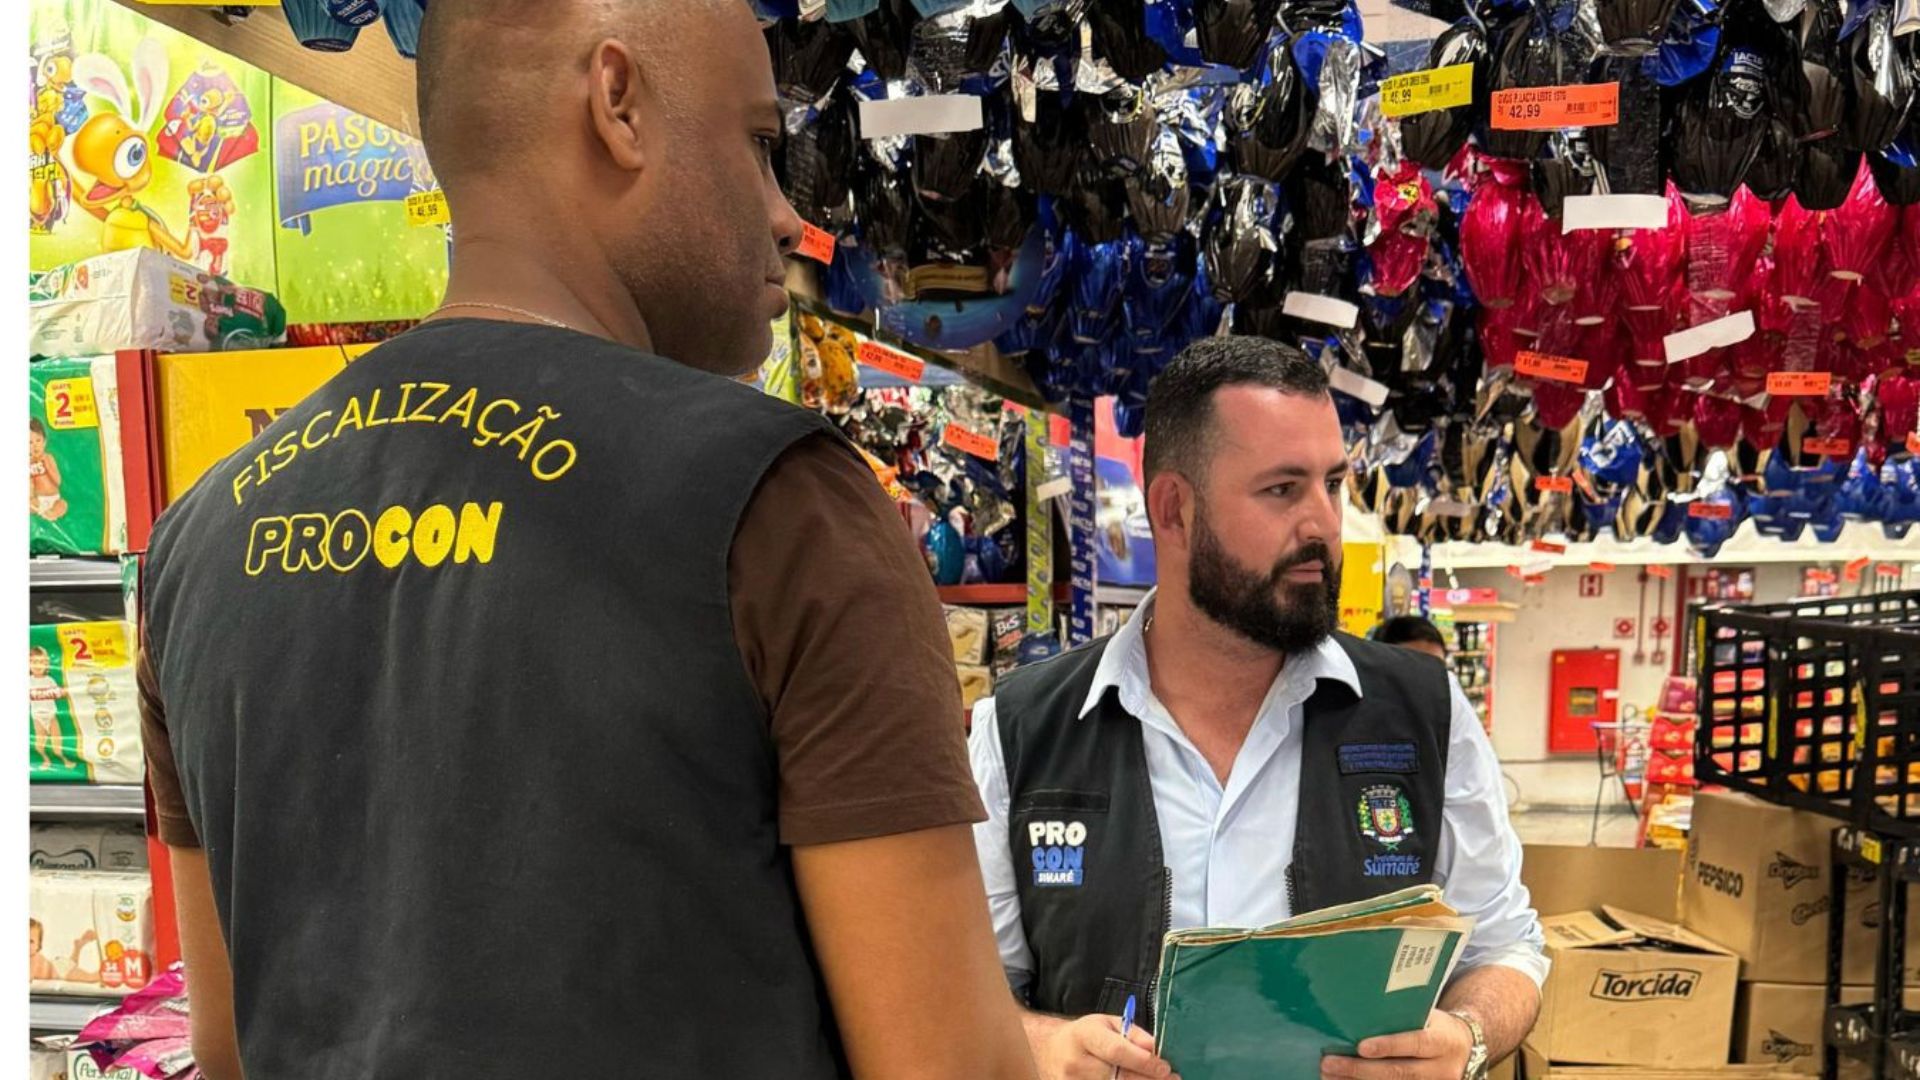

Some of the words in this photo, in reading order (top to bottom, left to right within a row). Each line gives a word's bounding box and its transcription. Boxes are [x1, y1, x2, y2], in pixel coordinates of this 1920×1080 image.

[1509, 104, 1541, 120] 42,99
[55, 392, 72, 418] 2
[232, 381, 578, 505] FISCALIZAÇÃO
[245, 502, 503, 575] PROCON
[70, 638, 93, 661] 2
[1028, 820, 1087, 847] PRO
[1032, 846, 1084, 870] CON
[1363, 857, 1421, 877] Sumaré
[1698, 861, 1743, 898] PEPSICO
[124, 955, 143, 978] M
[1601, 972, 1694, 997] Torcida
